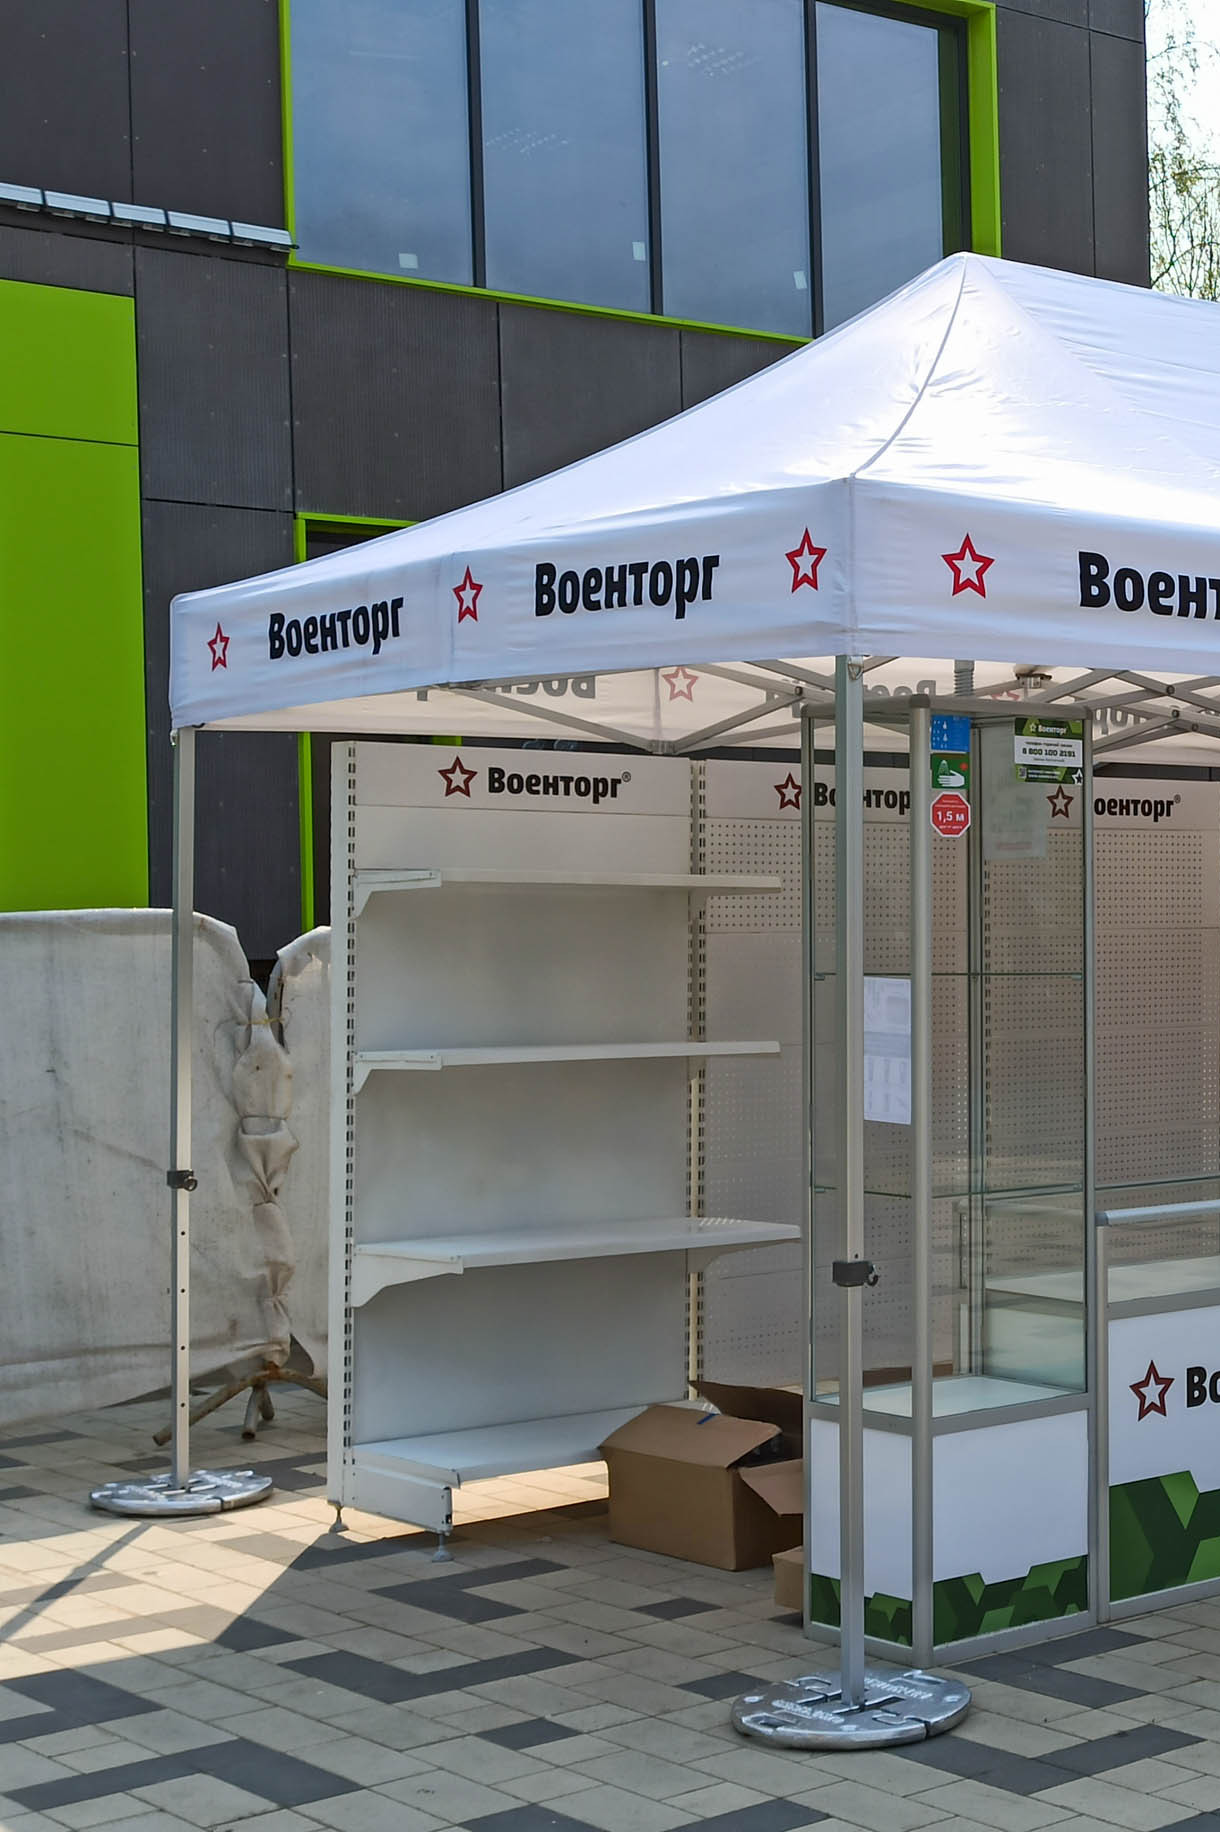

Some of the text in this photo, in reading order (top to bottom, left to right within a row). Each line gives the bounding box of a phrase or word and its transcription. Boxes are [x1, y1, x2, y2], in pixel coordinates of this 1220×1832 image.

[535, 554, 720, 620] Военторг
[268, 596, 405, 660] Военторг
[936, 810, 953, 824] 1,5
